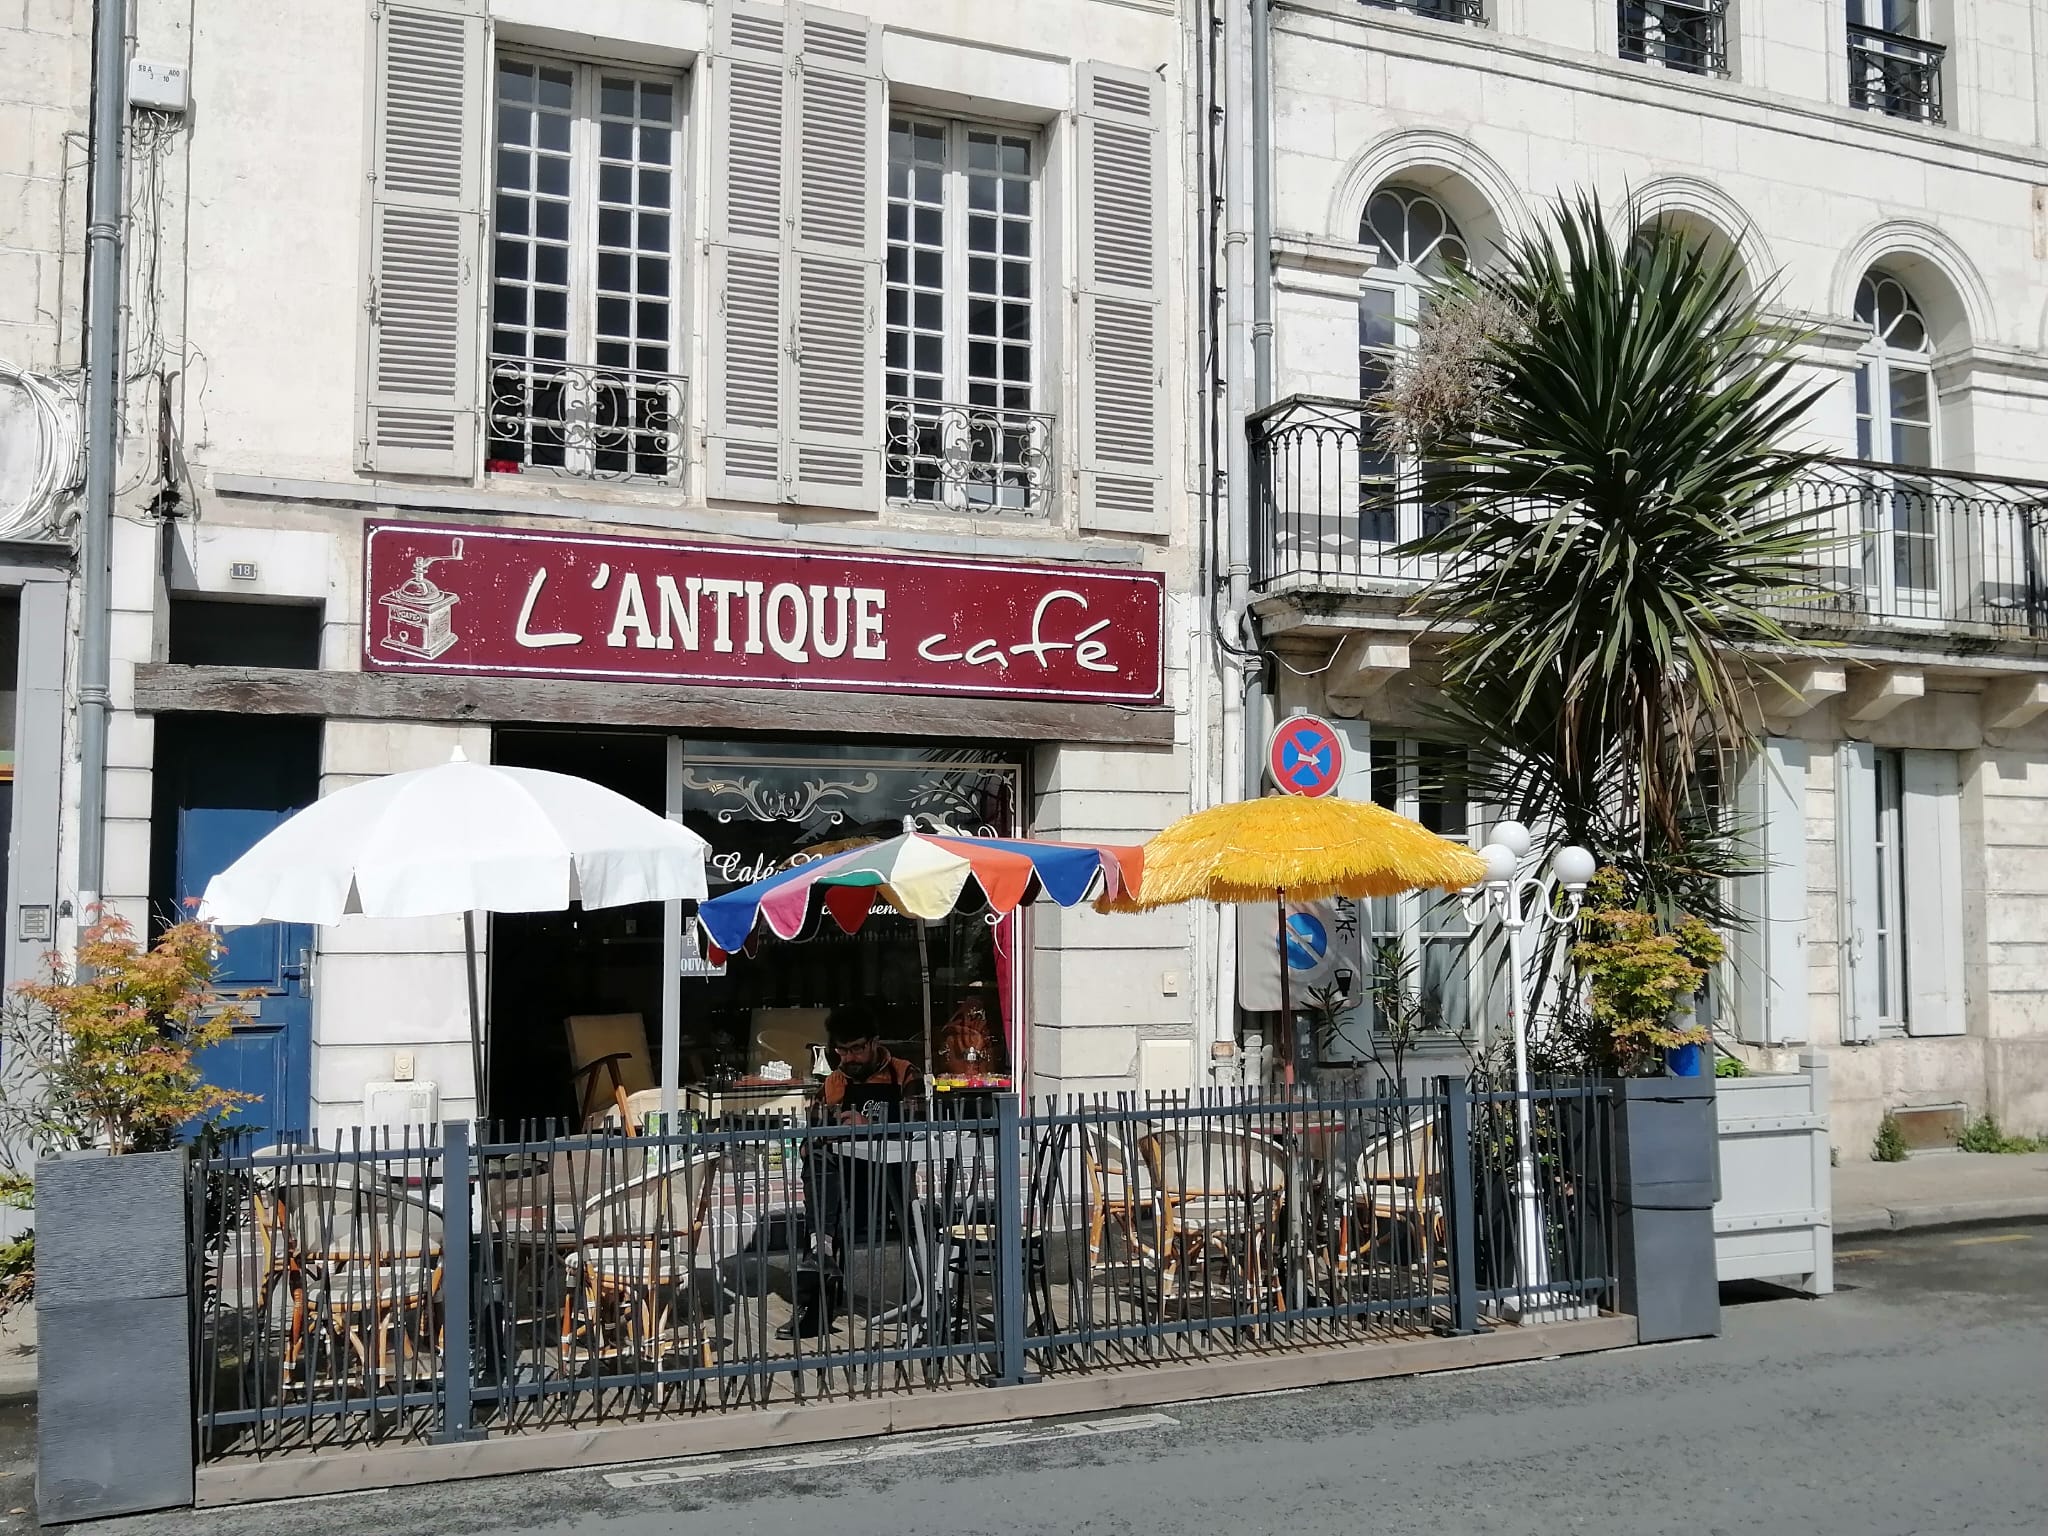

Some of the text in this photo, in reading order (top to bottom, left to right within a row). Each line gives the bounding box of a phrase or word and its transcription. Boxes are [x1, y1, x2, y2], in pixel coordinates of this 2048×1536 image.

[238, 565, 251, 576] 18
[514, 561, 1119, 673] L'ANTIQUE café
[681, 958, 722, 971] OUV
